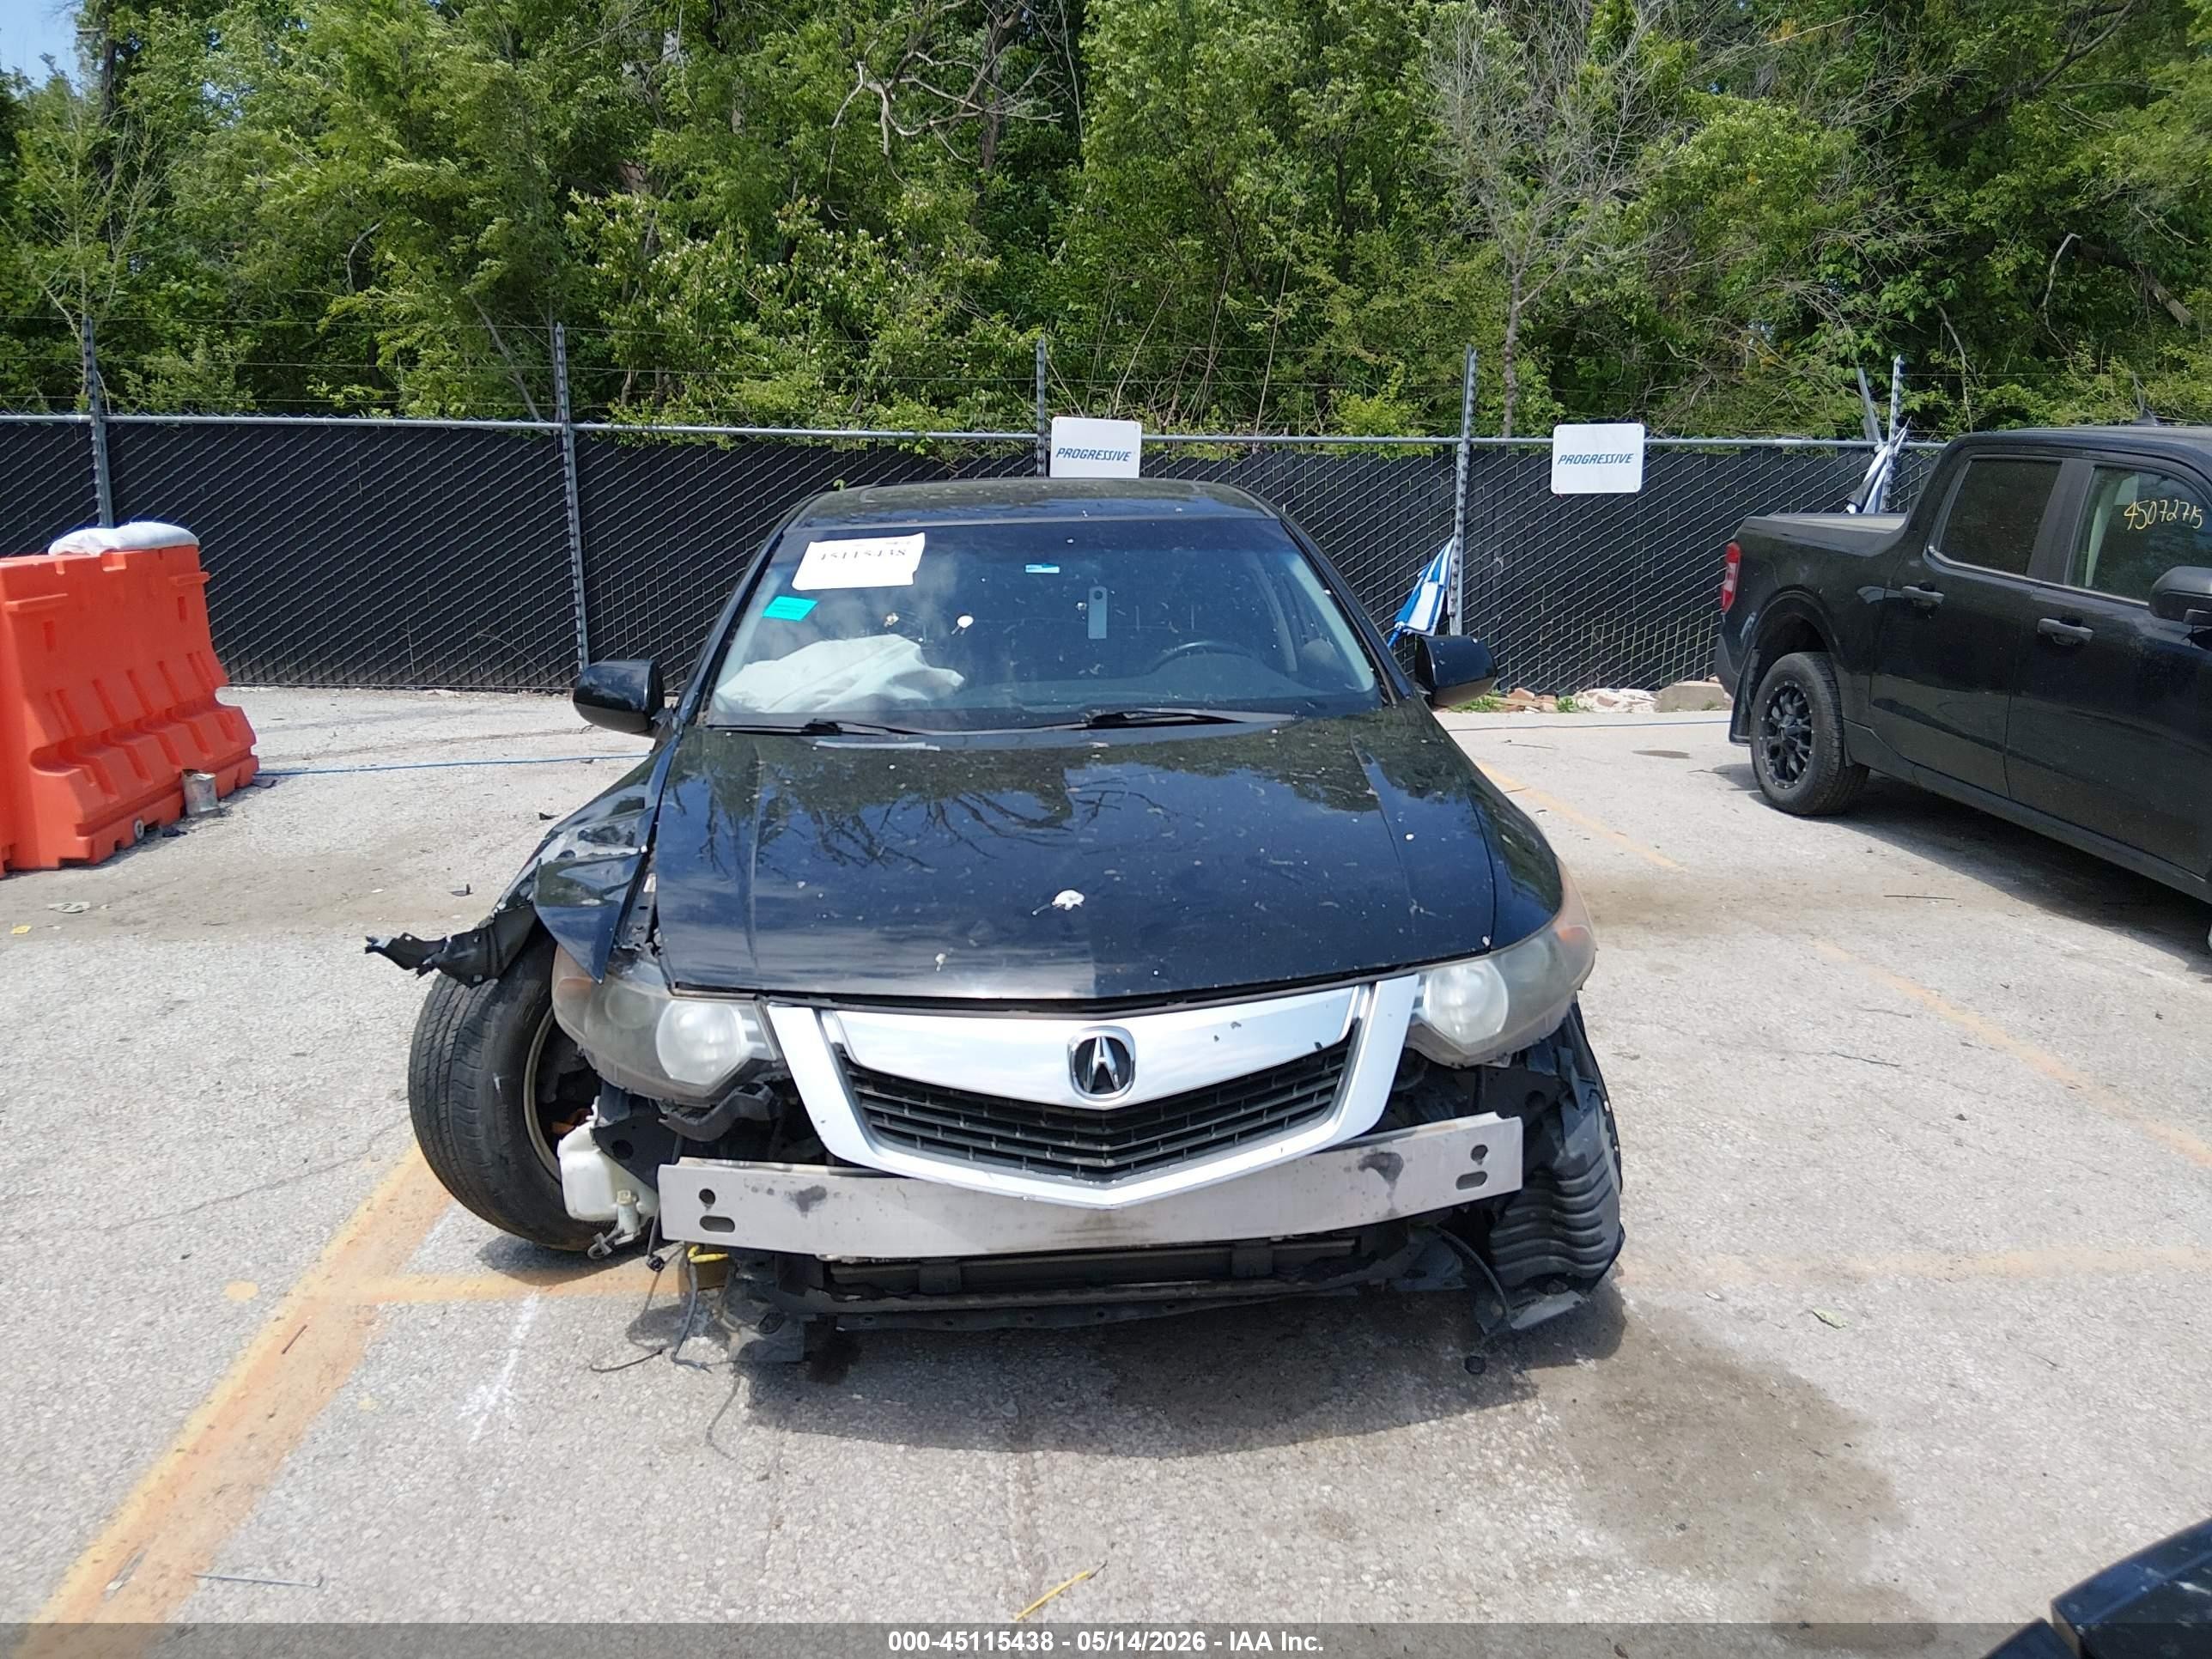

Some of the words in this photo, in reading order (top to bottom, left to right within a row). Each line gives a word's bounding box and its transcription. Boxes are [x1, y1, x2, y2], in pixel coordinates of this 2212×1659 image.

[1055, 447, 1133, 462] PROGRESSIVE
[1557, 453, 1634, 465] PROGRESSIVE
[2123, 499, 2203, 531] 45072715
